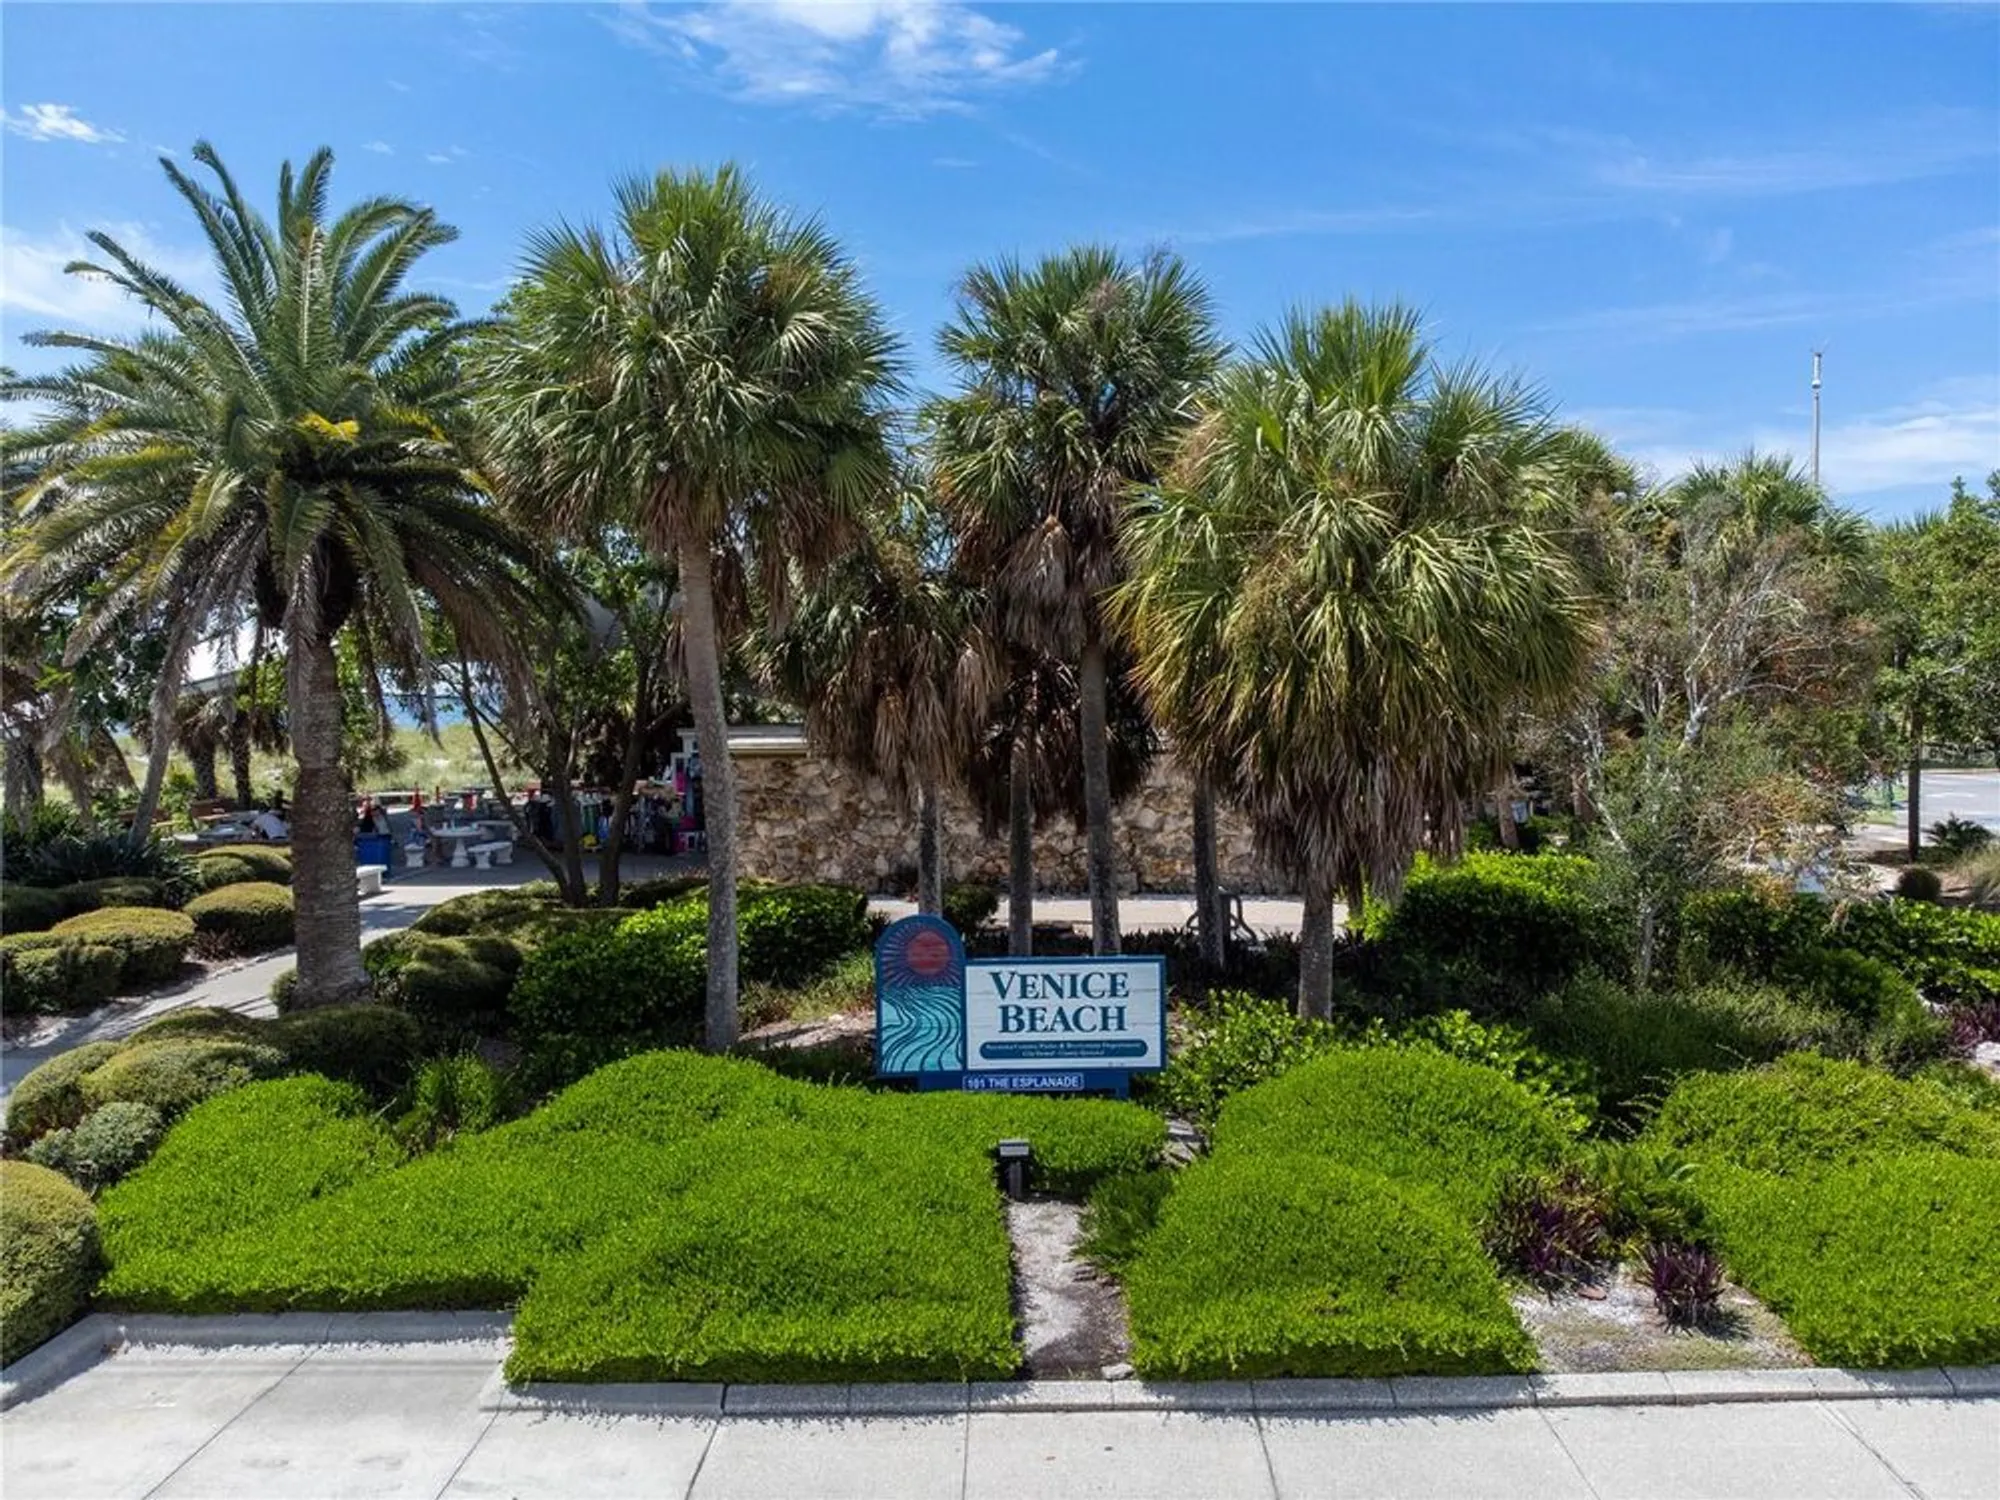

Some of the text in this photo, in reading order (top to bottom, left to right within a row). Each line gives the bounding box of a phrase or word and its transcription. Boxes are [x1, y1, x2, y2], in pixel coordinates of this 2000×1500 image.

[990, 971, 1130, 999] VENICE
[998, 1005, 1127, 1033] BEACH
[988, 1077, 1009, 1089] THE
[1012, 1076, 1079, 1088] ESPLANADE
